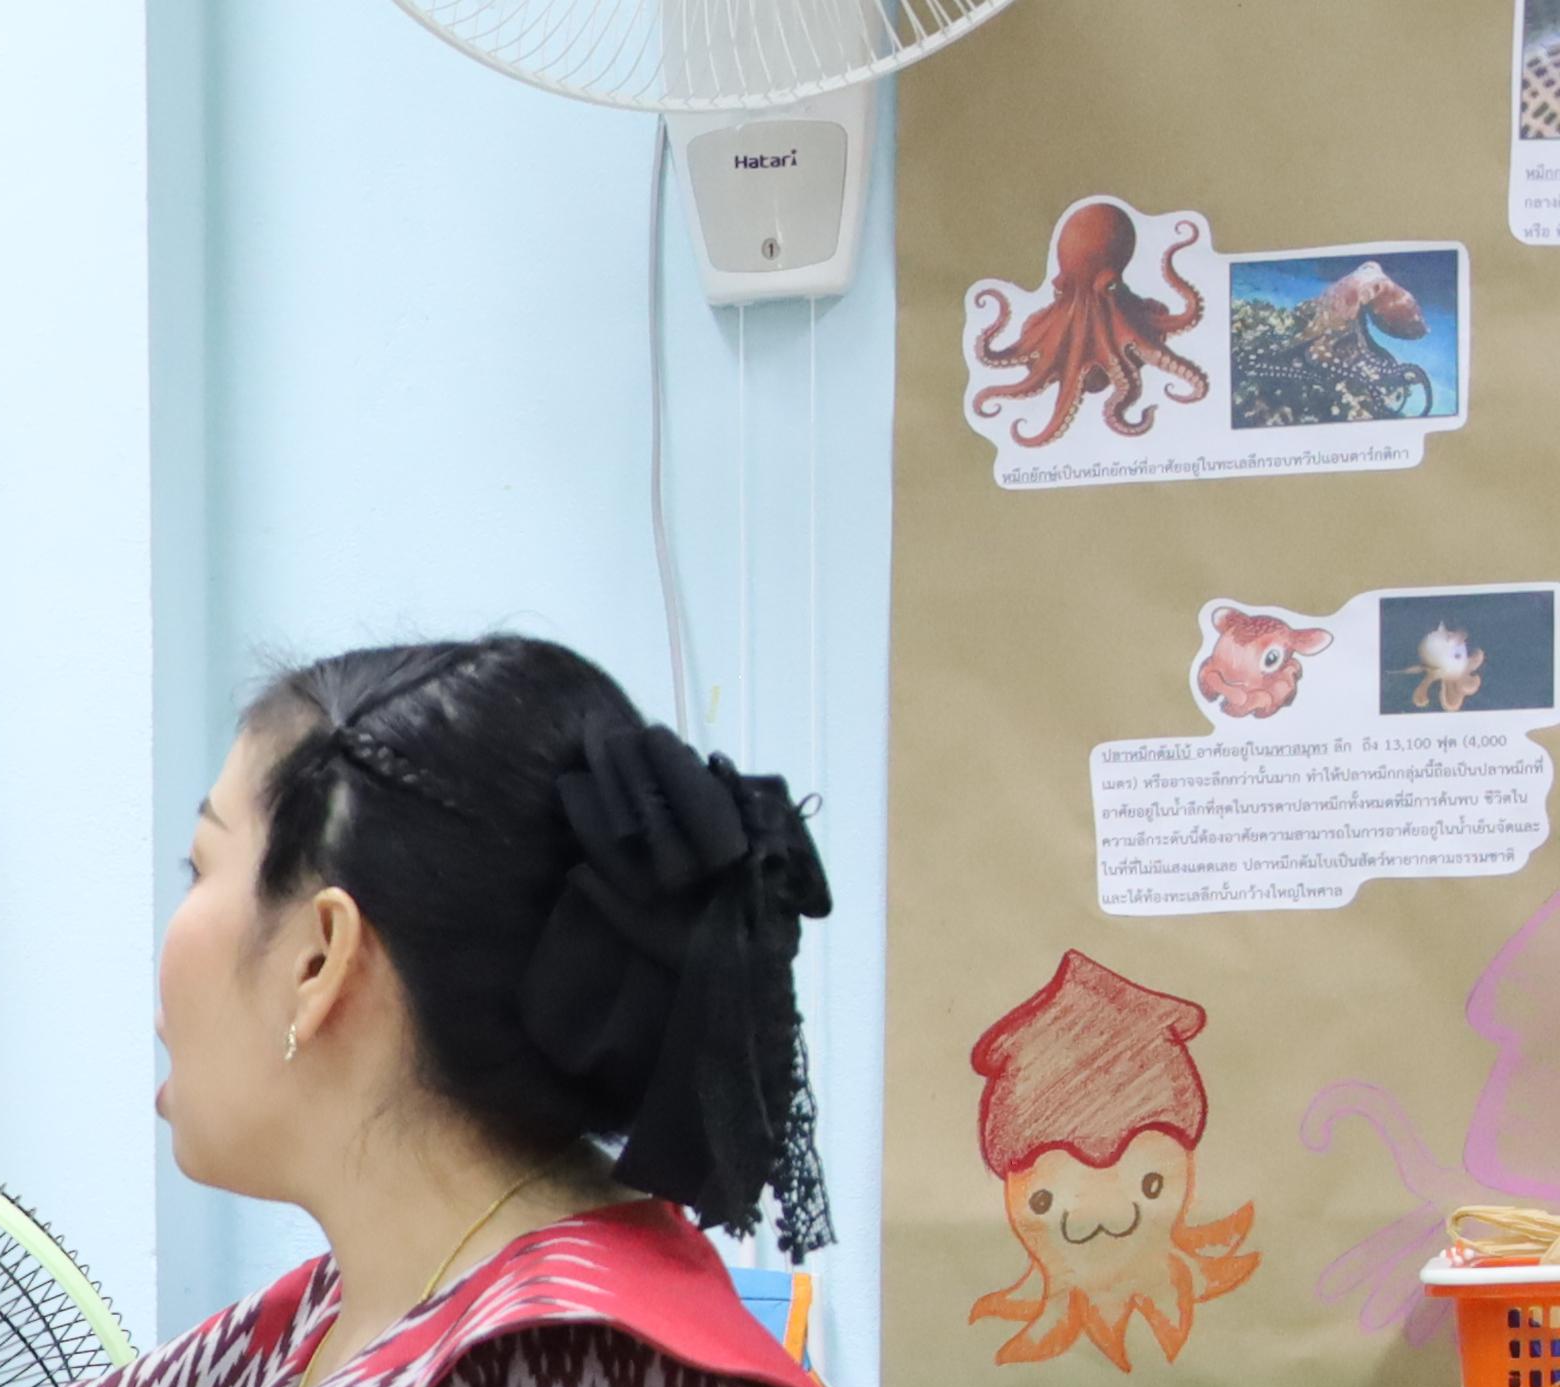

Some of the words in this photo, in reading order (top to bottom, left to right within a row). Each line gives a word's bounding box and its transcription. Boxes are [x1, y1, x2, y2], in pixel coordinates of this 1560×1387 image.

[734, 149, 797, 169] Hatari
[1385, 738, 1432, 753] 13,100
[1462, 734, 1508, 751] (4,000
